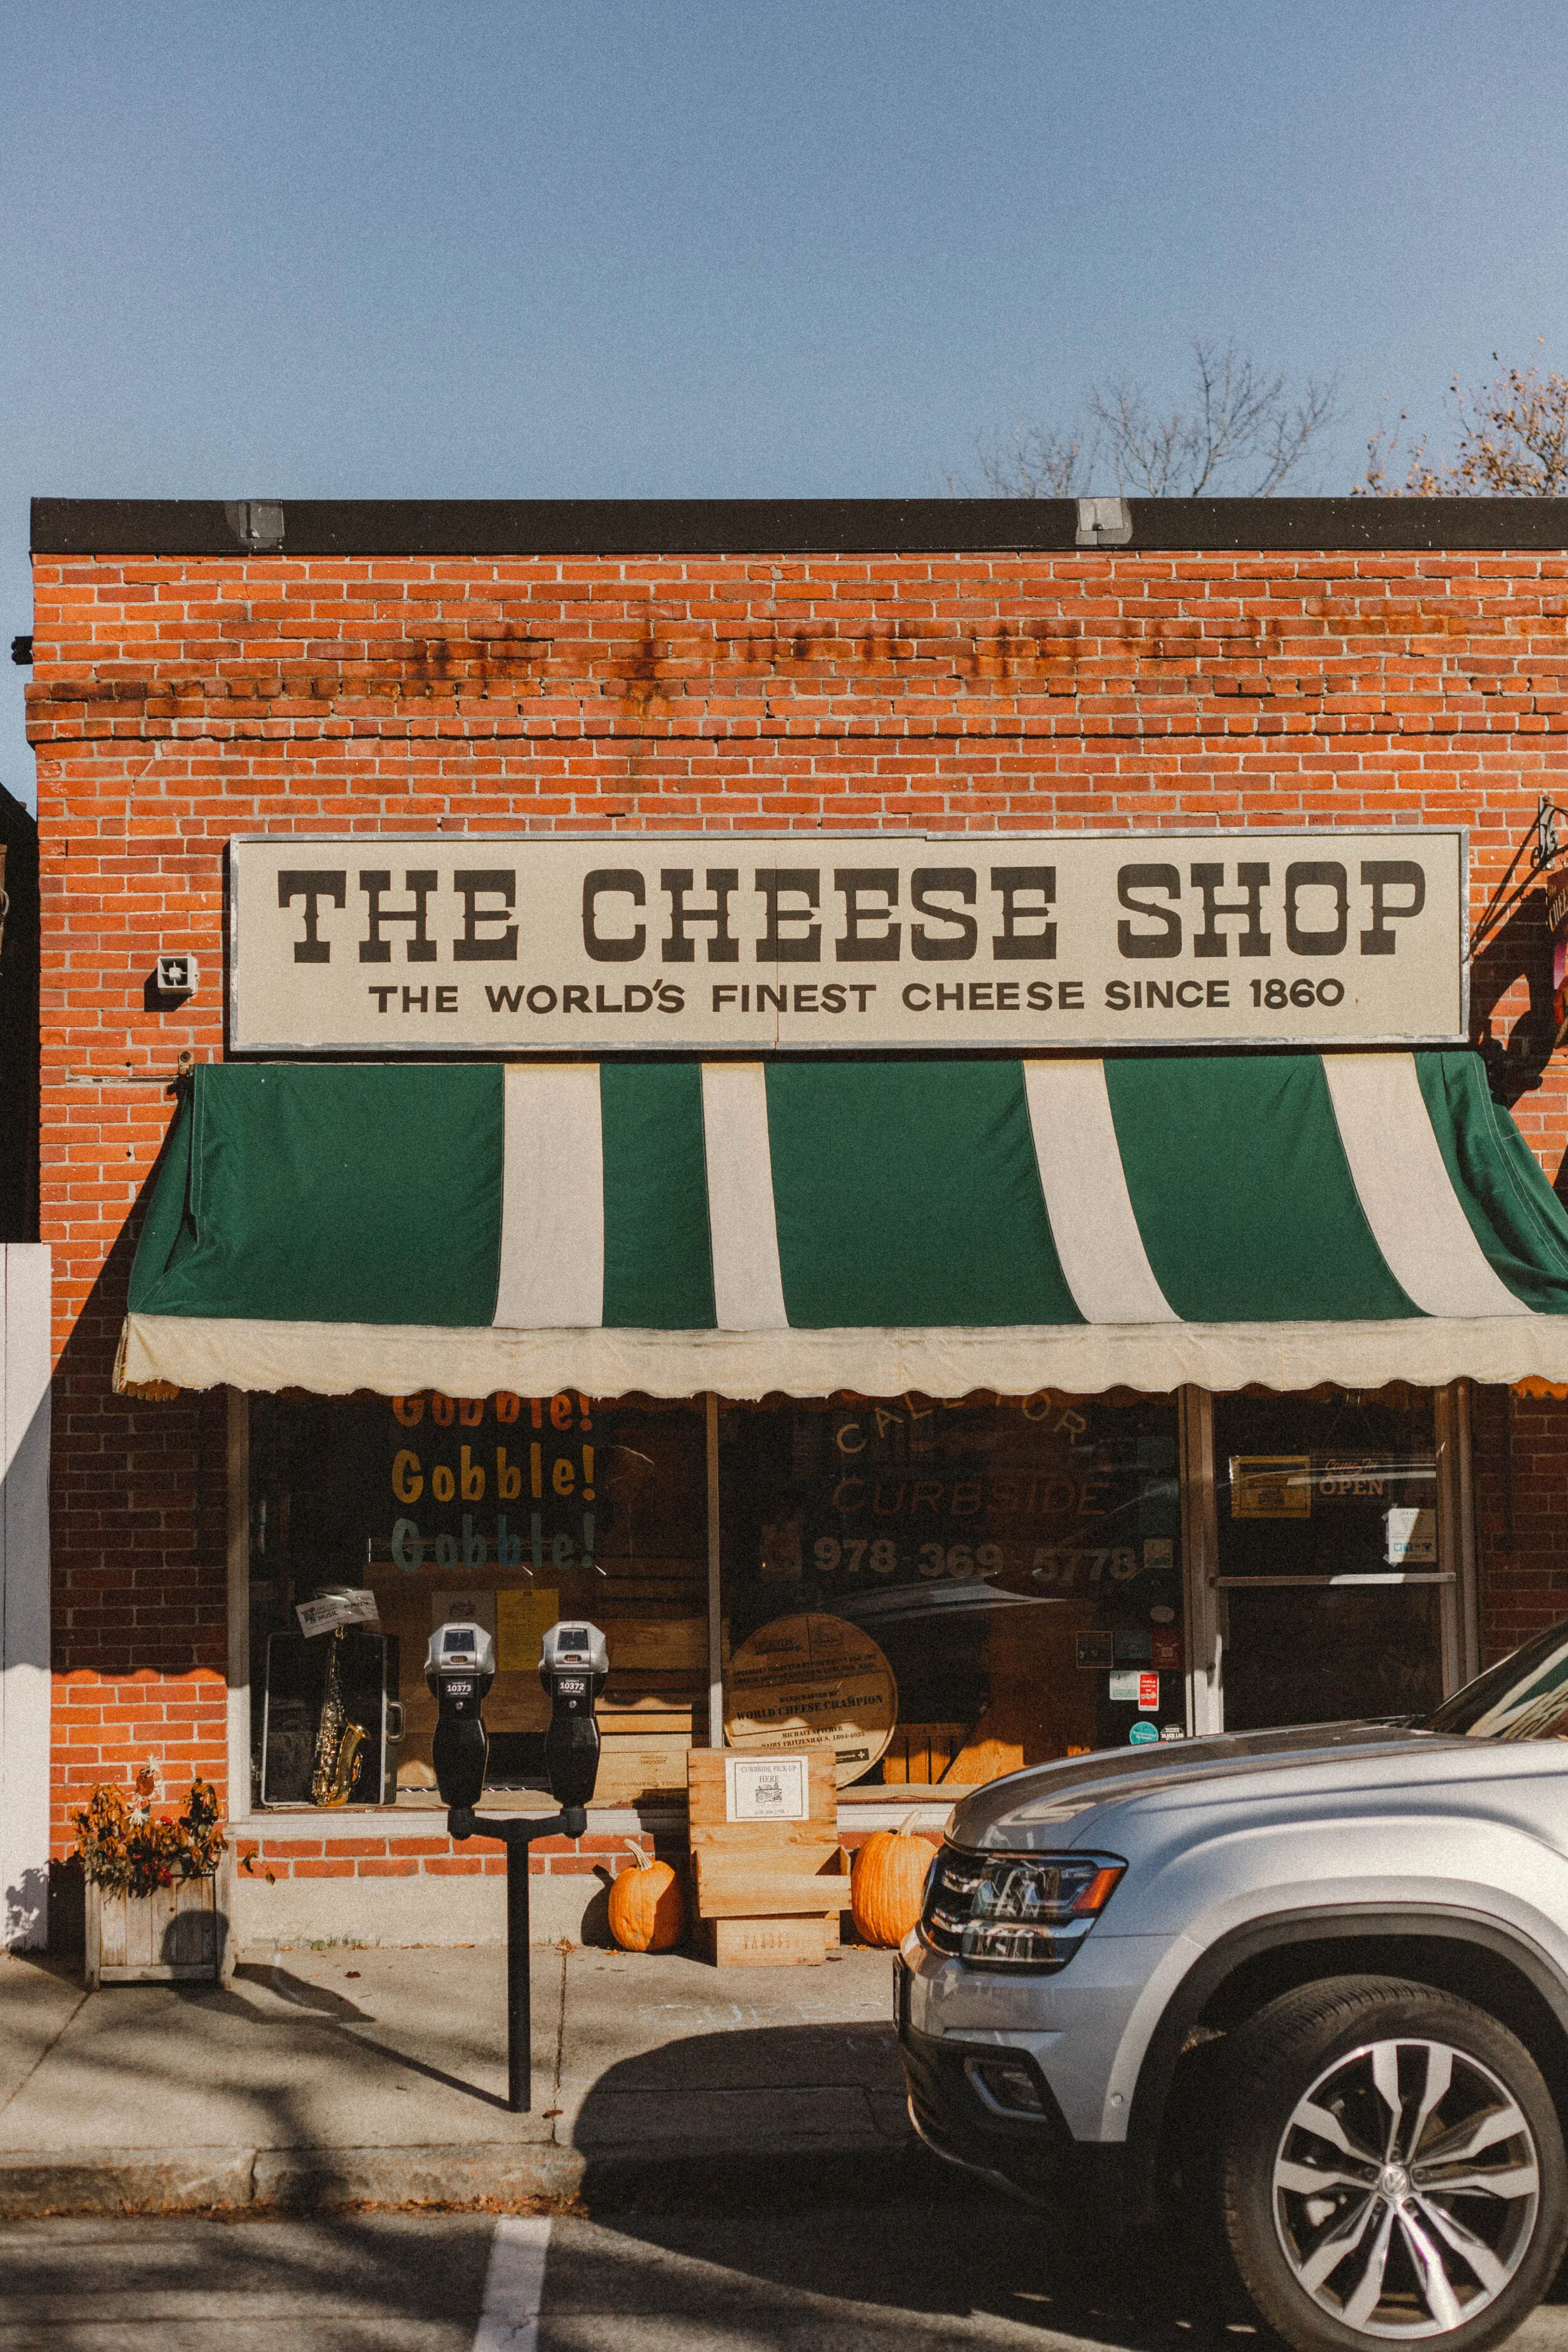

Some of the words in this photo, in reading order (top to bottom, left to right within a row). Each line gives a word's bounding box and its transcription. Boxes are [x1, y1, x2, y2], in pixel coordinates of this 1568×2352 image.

[278, 870, 519, 963] THE
[582, 867, 1057, 962] CHEESE
[1117, 861, 1426, 959] SHOP
[369, 985, 458, 1013] THE
[484, 979, 685, 1014] WORLD'S
[712, 983, 877, 1013] FINEST
[902, 981, 1084, 1012] CHEESE
[1104, 980, 1229, 1010] SINCE
[1249, 978, 1345, 1010] 1860
[996, 1392, 1086, 1445] OR
[392, 1443, 595, 1503] Gobble!
[1319, 1477, 1385, 1495] OPEN
[833, 1478, 1110, 1516] CURBSIDE
[392, 1512, 595, 1572] Gobble!
[318, 1610, 339, 1621] MUSIC
[560, 1682, 584, 1690] 10372
[736, 1707, 776, 1720] WORLD
[778, 1702, 822, 1715] CHEESE
[824, 1695, 883, 1710] CHAMPION
[782, 1730, 810, 1738] MICHAEL
[812, 1726, 843, 1735] SPYCHER
